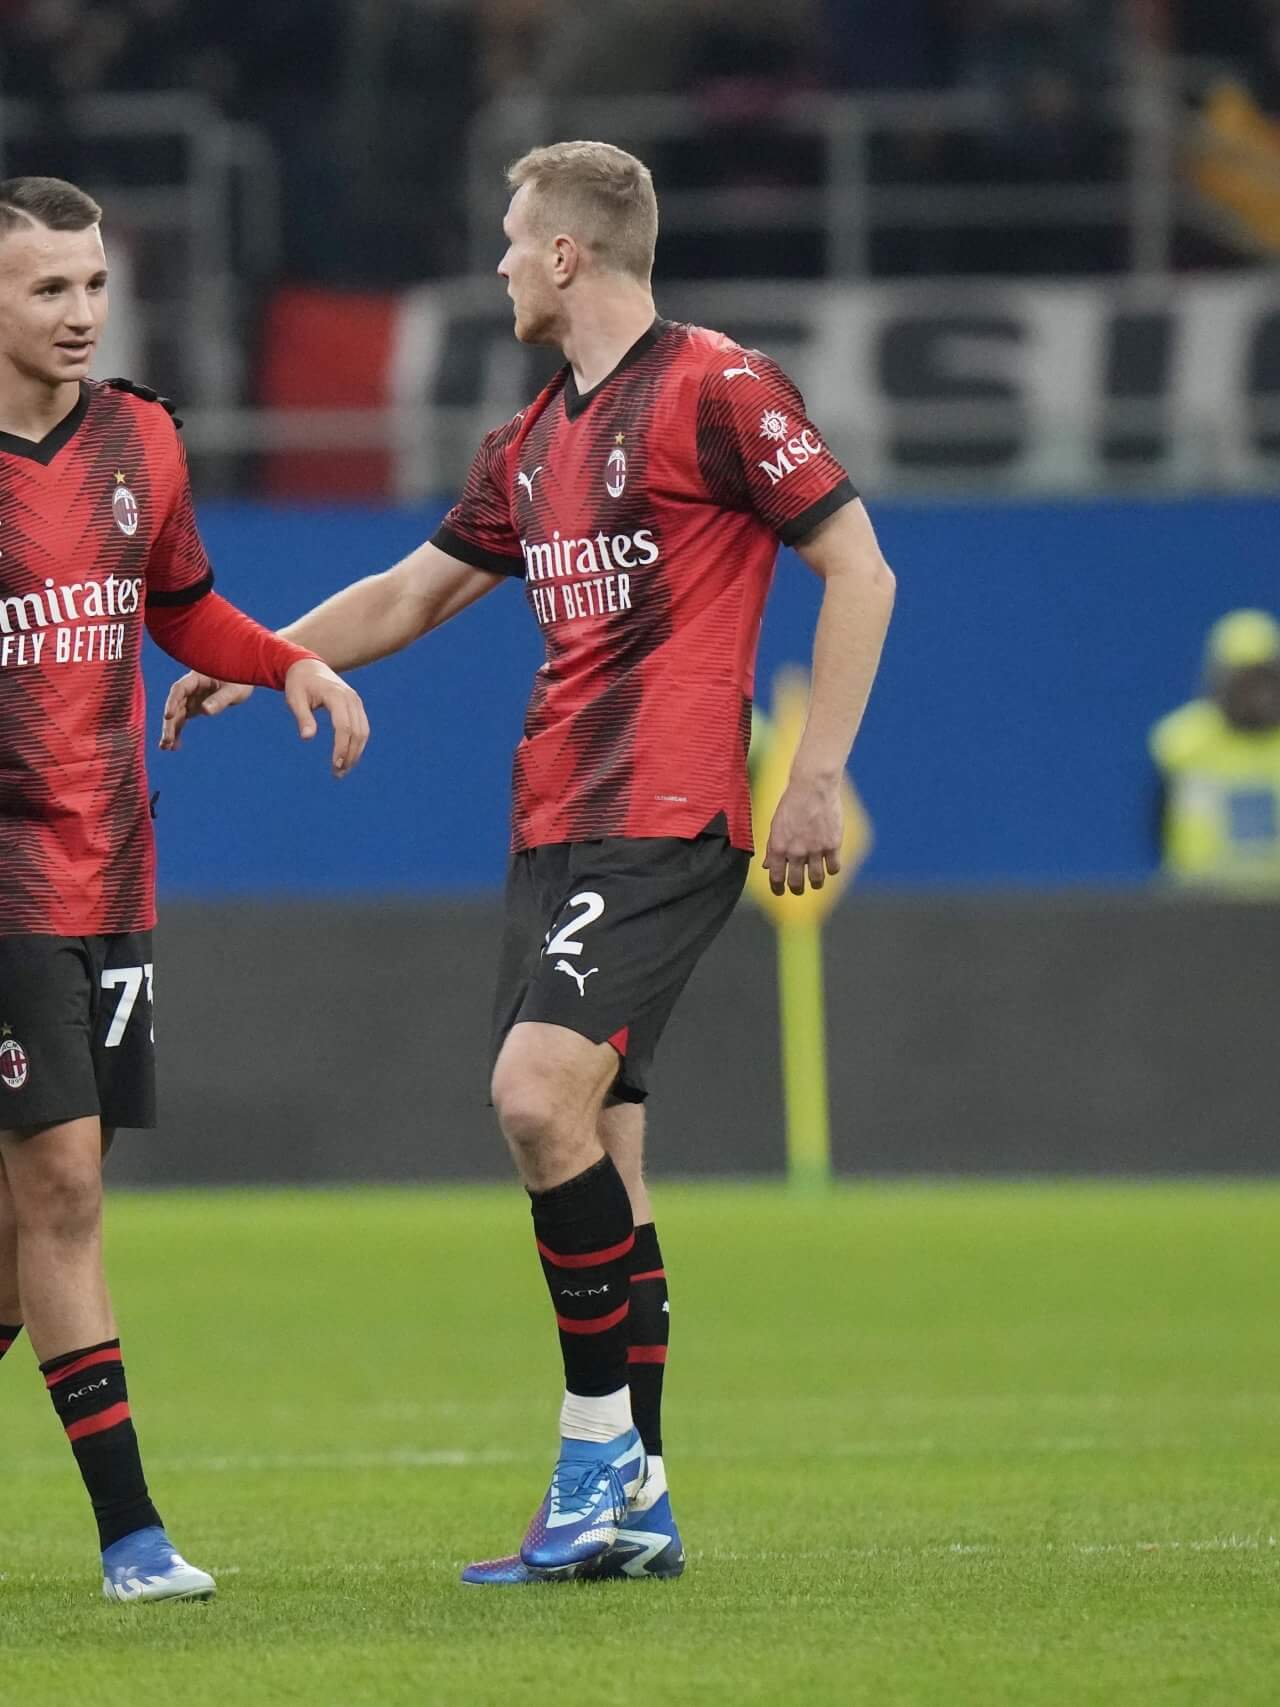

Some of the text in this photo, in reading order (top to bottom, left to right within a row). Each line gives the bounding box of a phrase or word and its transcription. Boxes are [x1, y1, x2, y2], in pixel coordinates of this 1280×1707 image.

[759, 429, 822, 486] MSC
[520, 529, 659, 583] mirates
[532, 573, 632, 624] FLY BETTER
[1, 623, 124, 667] FLY BETTER
[541, 891, 605, 958] 2
[560, 1284, 609, 1297] ACM
[67, 1377, 108, 1402] ACM
